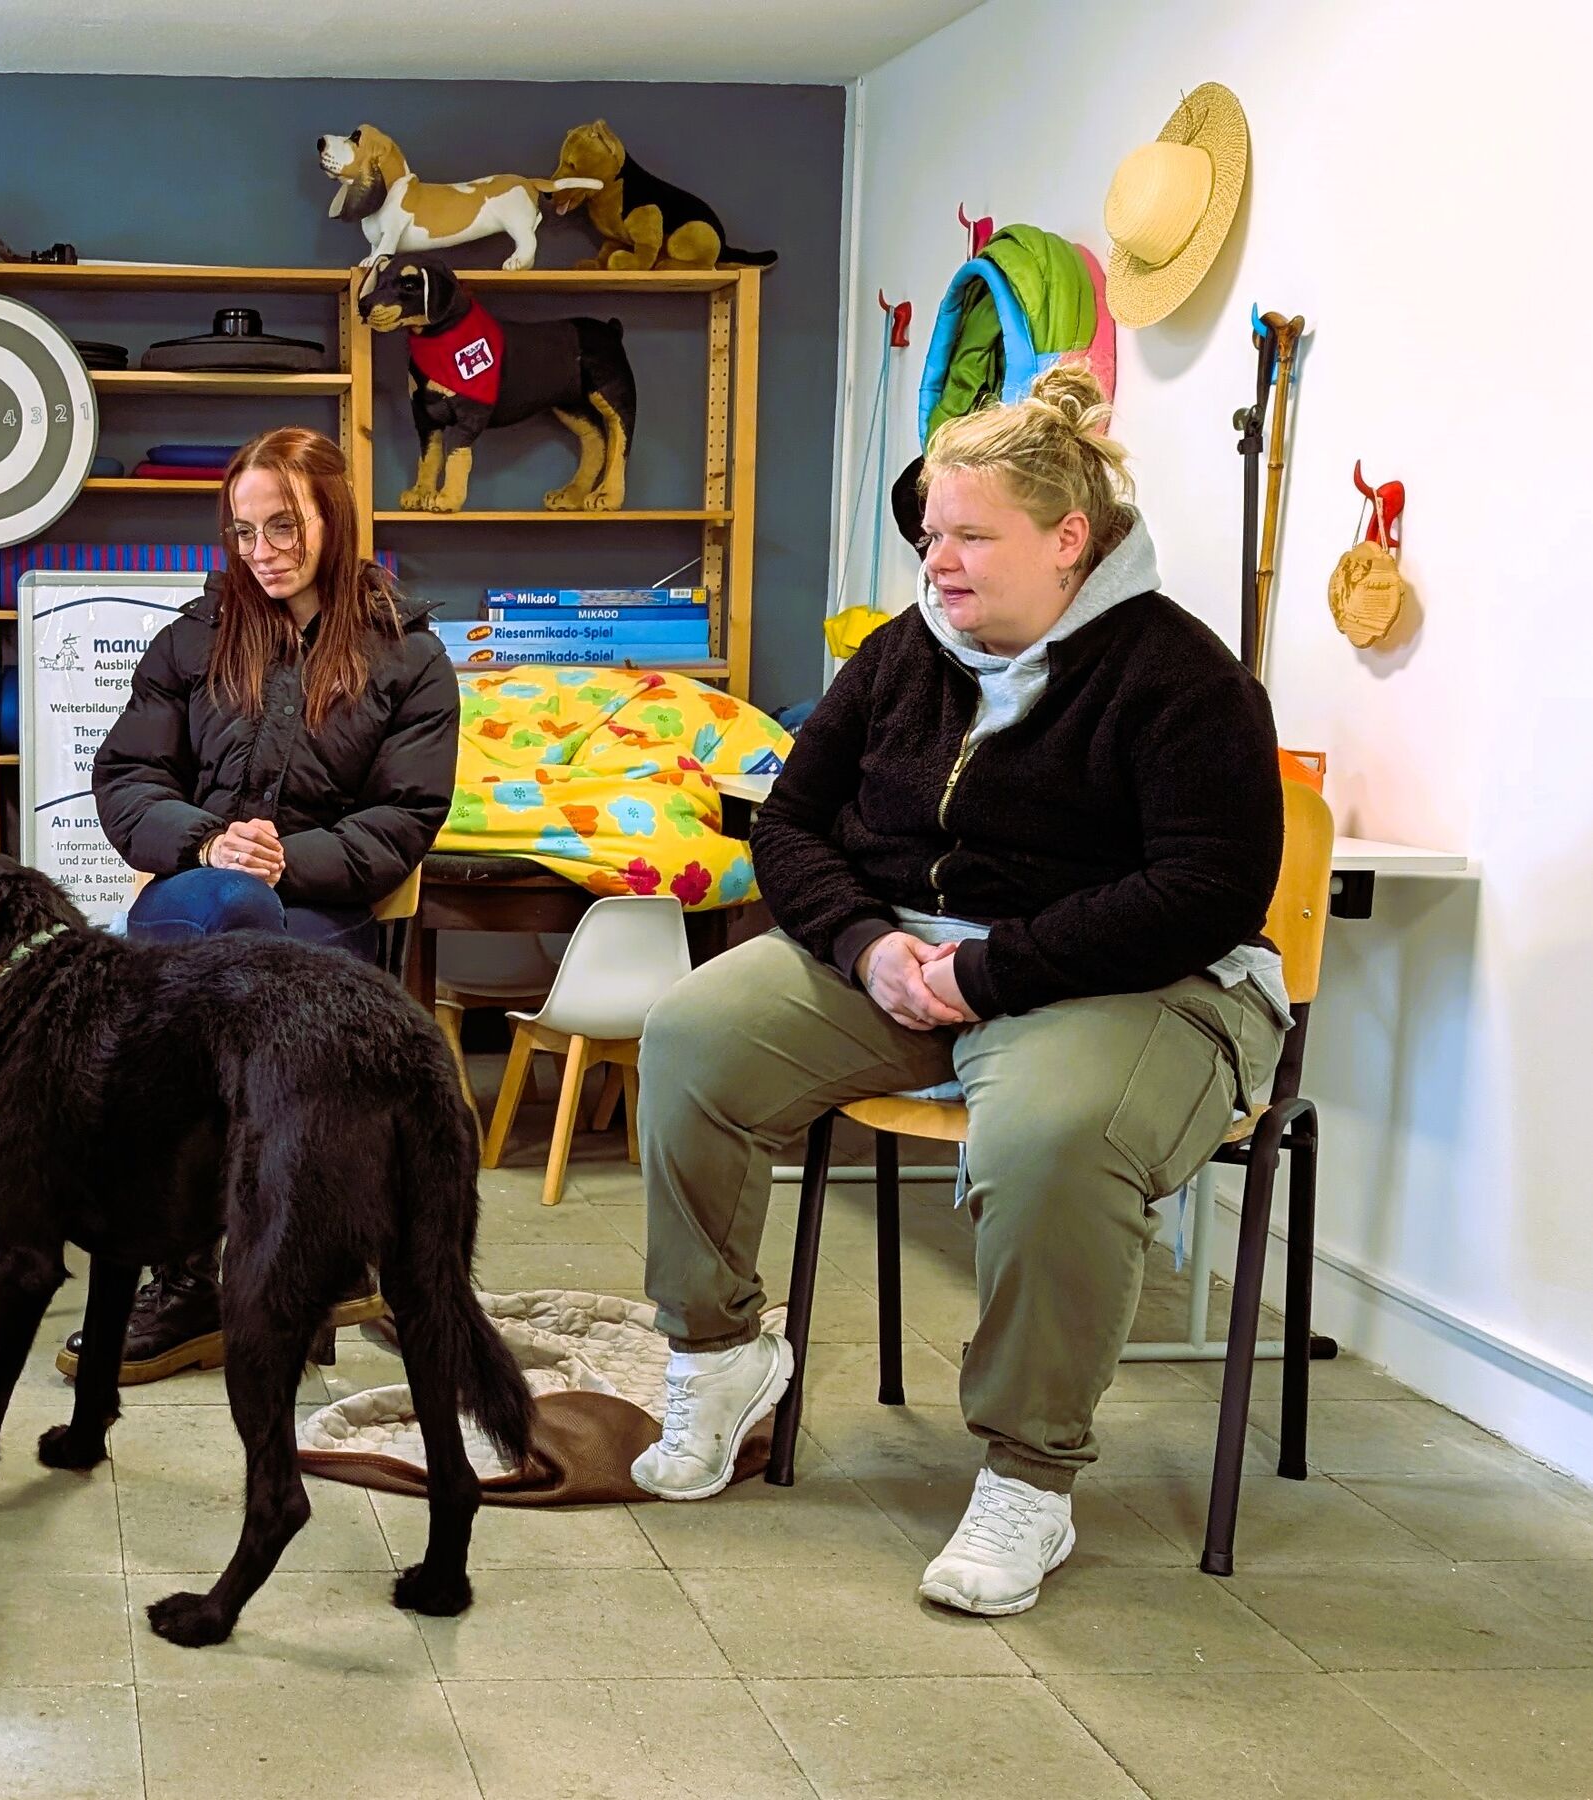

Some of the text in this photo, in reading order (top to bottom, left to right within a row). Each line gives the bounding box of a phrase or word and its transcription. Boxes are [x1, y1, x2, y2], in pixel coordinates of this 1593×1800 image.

[3, 409, 16, 426] 4
[30, 406, 42, 423] 3
[55, 404, 67, 422] 2
[80, 402, 90, 419] 1
[517, 593, 556, 604] Mikado
[578, 610, 619, 619] MIKADO
[494, 626, 613, 640] Riesenmikado-Spiel
[495, 650, 614, 662] Riesenmikado-Spiel
[73, 726, 111, 737] Thera
[52, 816, 70, 828] An
[56, 841, 114, 851] Informatio
[58, 855, 78, 865] und
[84, 874, 93, 884] &
[100, 892, 125, 904] Rally
